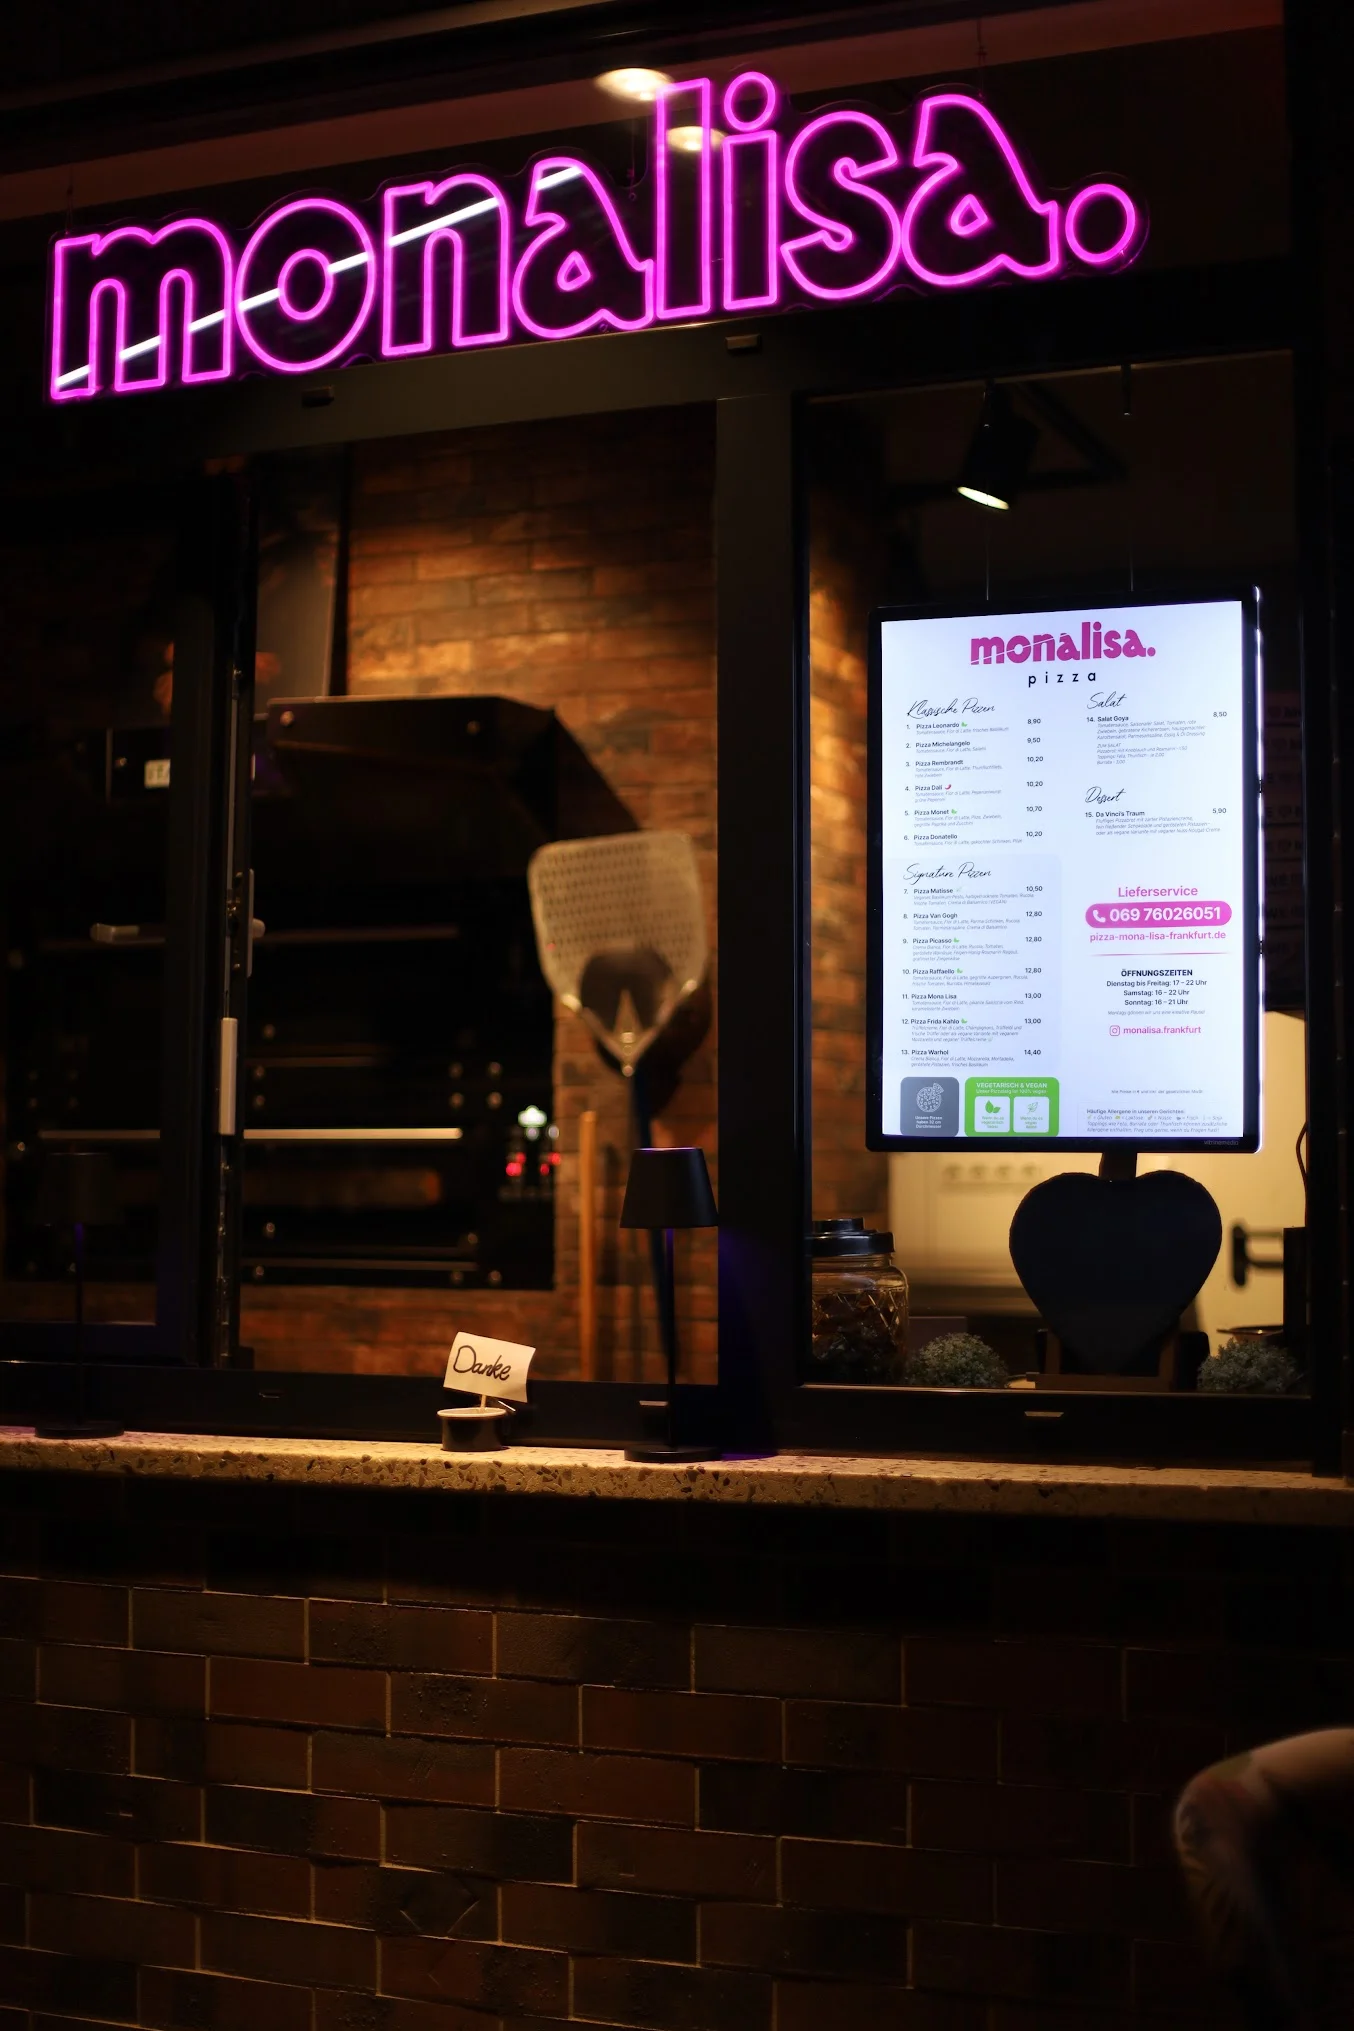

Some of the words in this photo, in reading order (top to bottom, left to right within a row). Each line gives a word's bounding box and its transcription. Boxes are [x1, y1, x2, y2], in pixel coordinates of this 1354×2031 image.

[49, 71, 1139, 401] monalisa.
[971, 621, 1156, 665] monalisa.
[1028, 671, 1096, 688] pizza
[907, 698, 958, 719] Klassische
[1087, 691, 1127, 709] Salat
[1085, 786, 1126, 804] Dessert
[903, 863, 954, 885] Signature
[1118, 886, 1198, 898] Lieferservice
[1110, 908, 1140, 922] 069
[1143, 907, 1221, 920] 76026051
[1090, 931, 1226, 943] pizza-mona-lisa-frankfurt.de
[1121, 968, 1193, 977] ÖFFNUNGSZEITEN
[1123, 1026, 1201, 1034] monalisa.frankfurt
[453, 1345, 512, 1380] Danke
